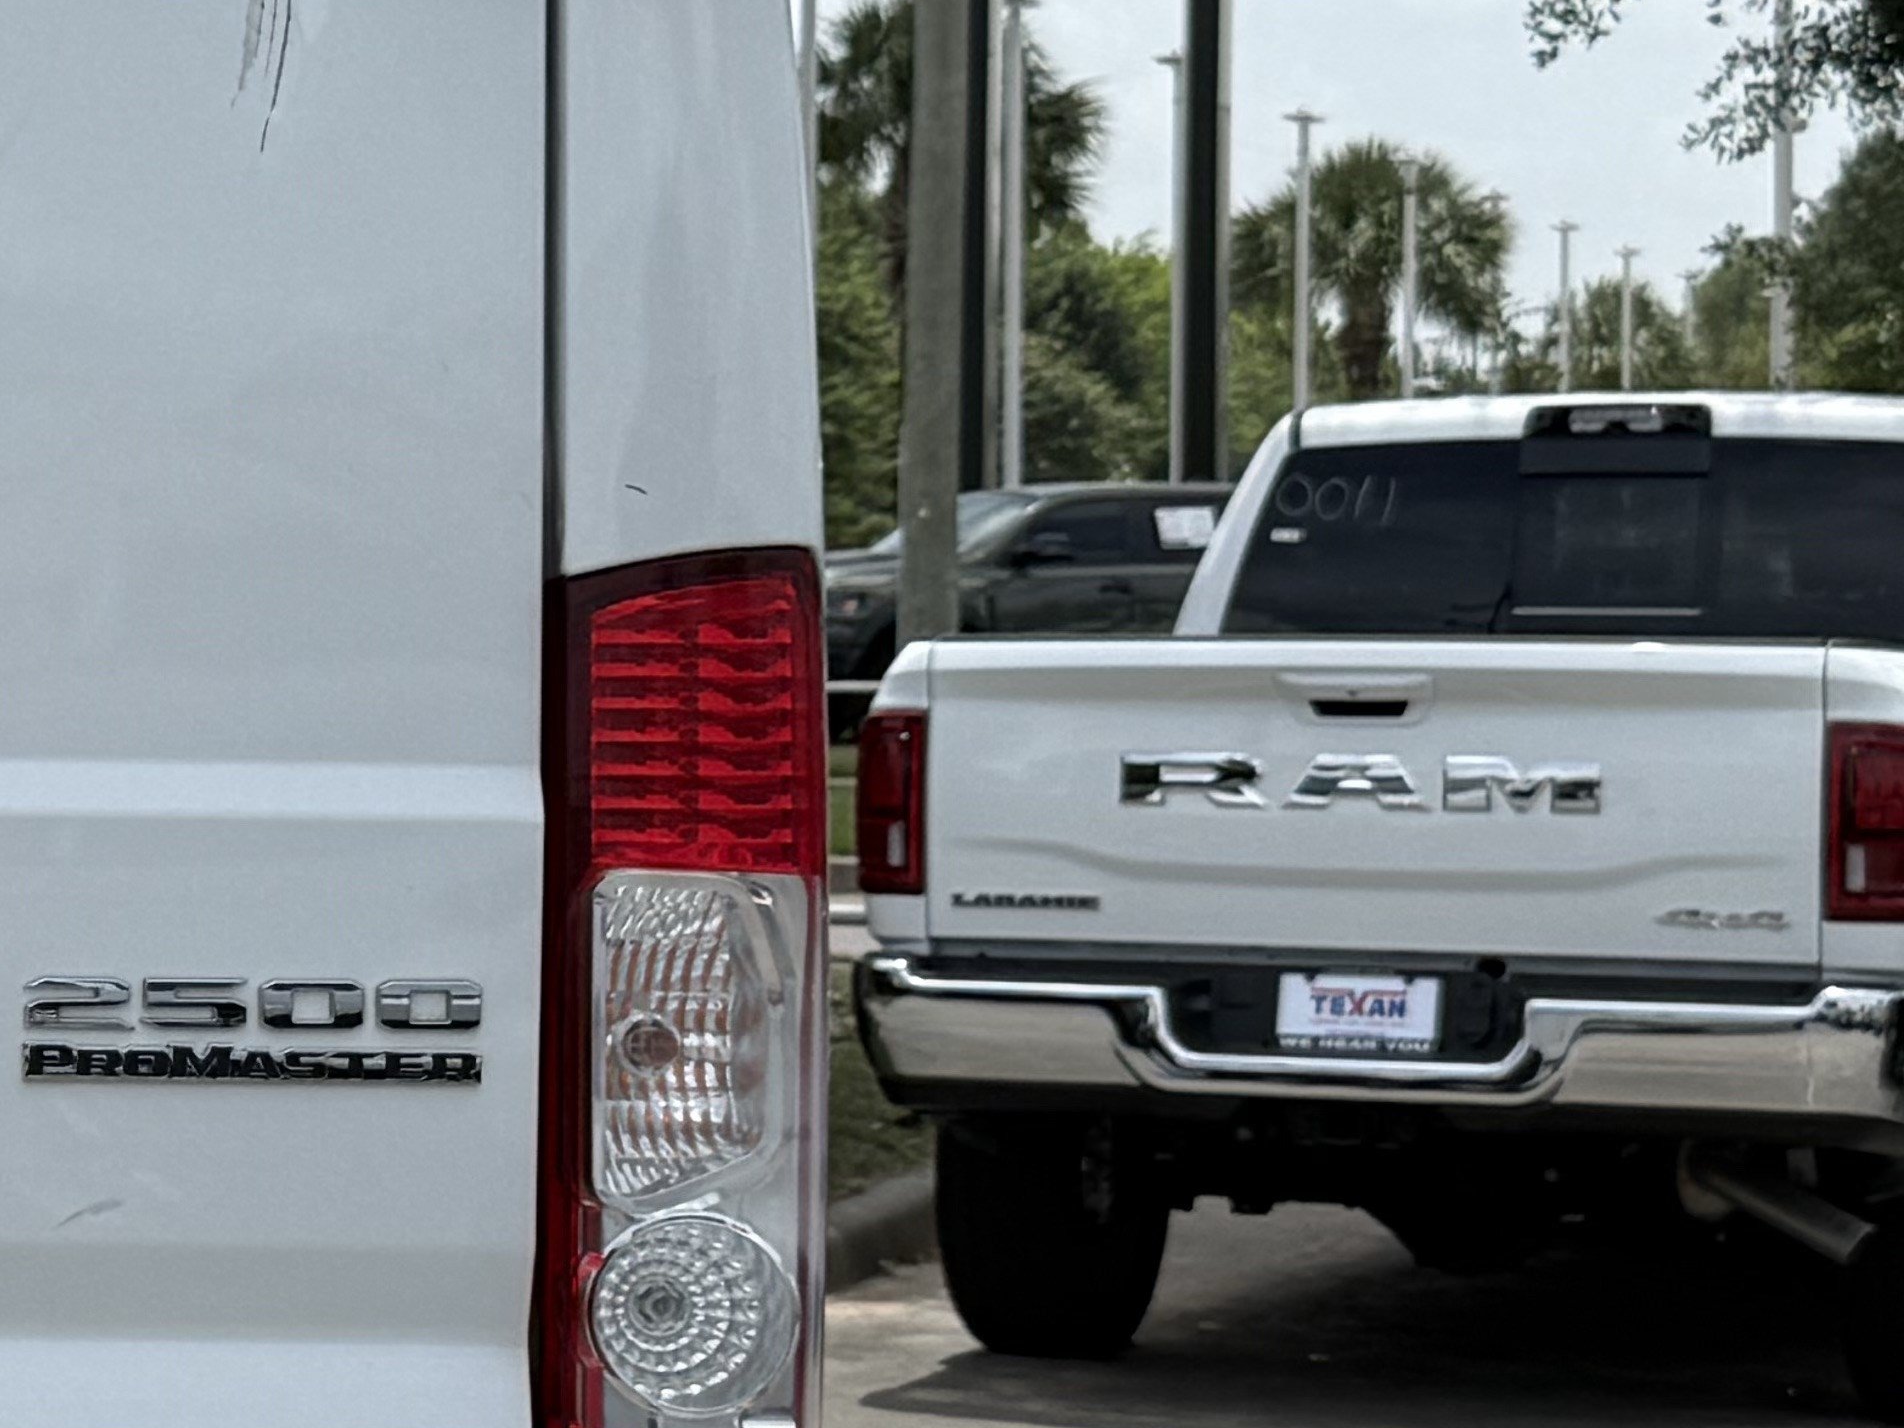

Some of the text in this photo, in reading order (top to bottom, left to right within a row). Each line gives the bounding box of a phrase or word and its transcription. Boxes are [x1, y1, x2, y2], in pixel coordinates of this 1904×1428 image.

[1119, 752, 1602, 813] RAM
[23, 975, 483, 1029] 2500
[1311, 990, 1407, 1018] TEXAN
